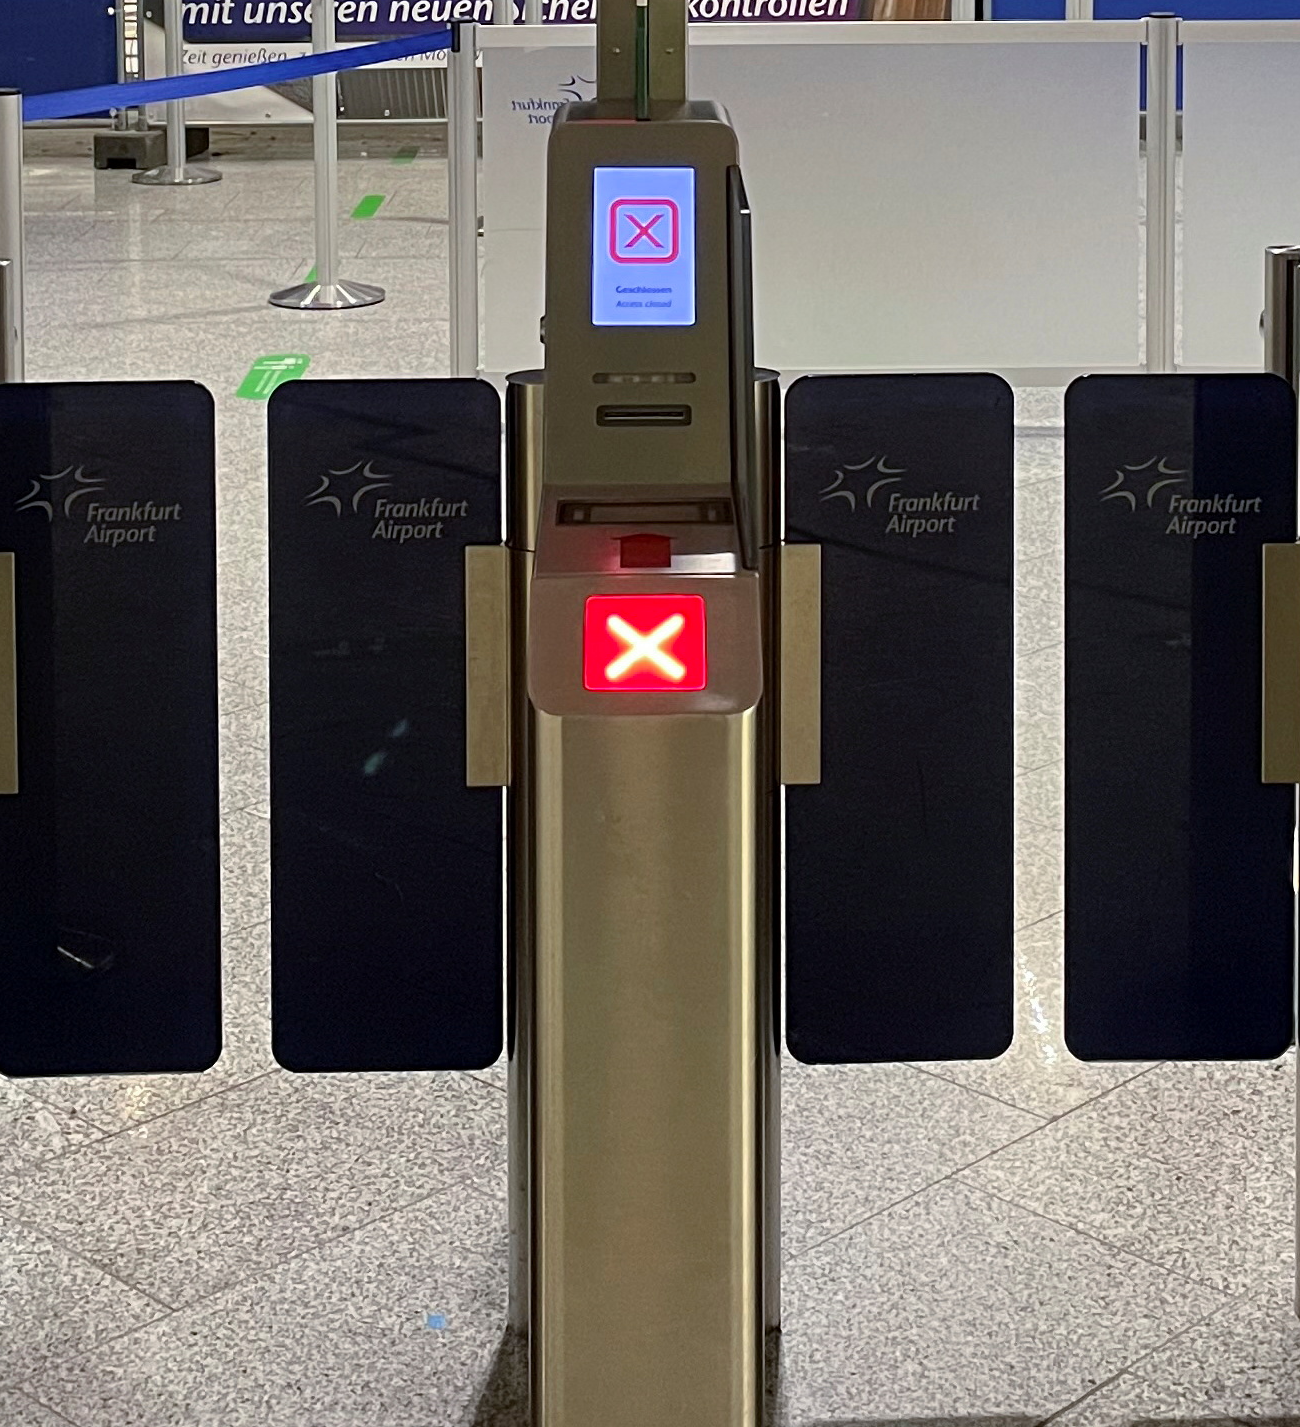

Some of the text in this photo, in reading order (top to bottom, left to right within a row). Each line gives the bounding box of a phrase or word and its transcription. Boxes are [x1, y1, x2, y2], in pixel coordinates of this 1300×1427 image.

[86, 501, 182, 523] Frankfurt
[374, 498, 469, 519] Frankfurt
[888, 492, 980, 513] Frankfurt
[1168, 493, 1262, 515] Frankfurt
[83, 522, 157, 548] Airport
[371, 519, 443, 544] Airport
[885, 512, 956, 538] Airport
[1165, 515, 1237, 539] Airport
